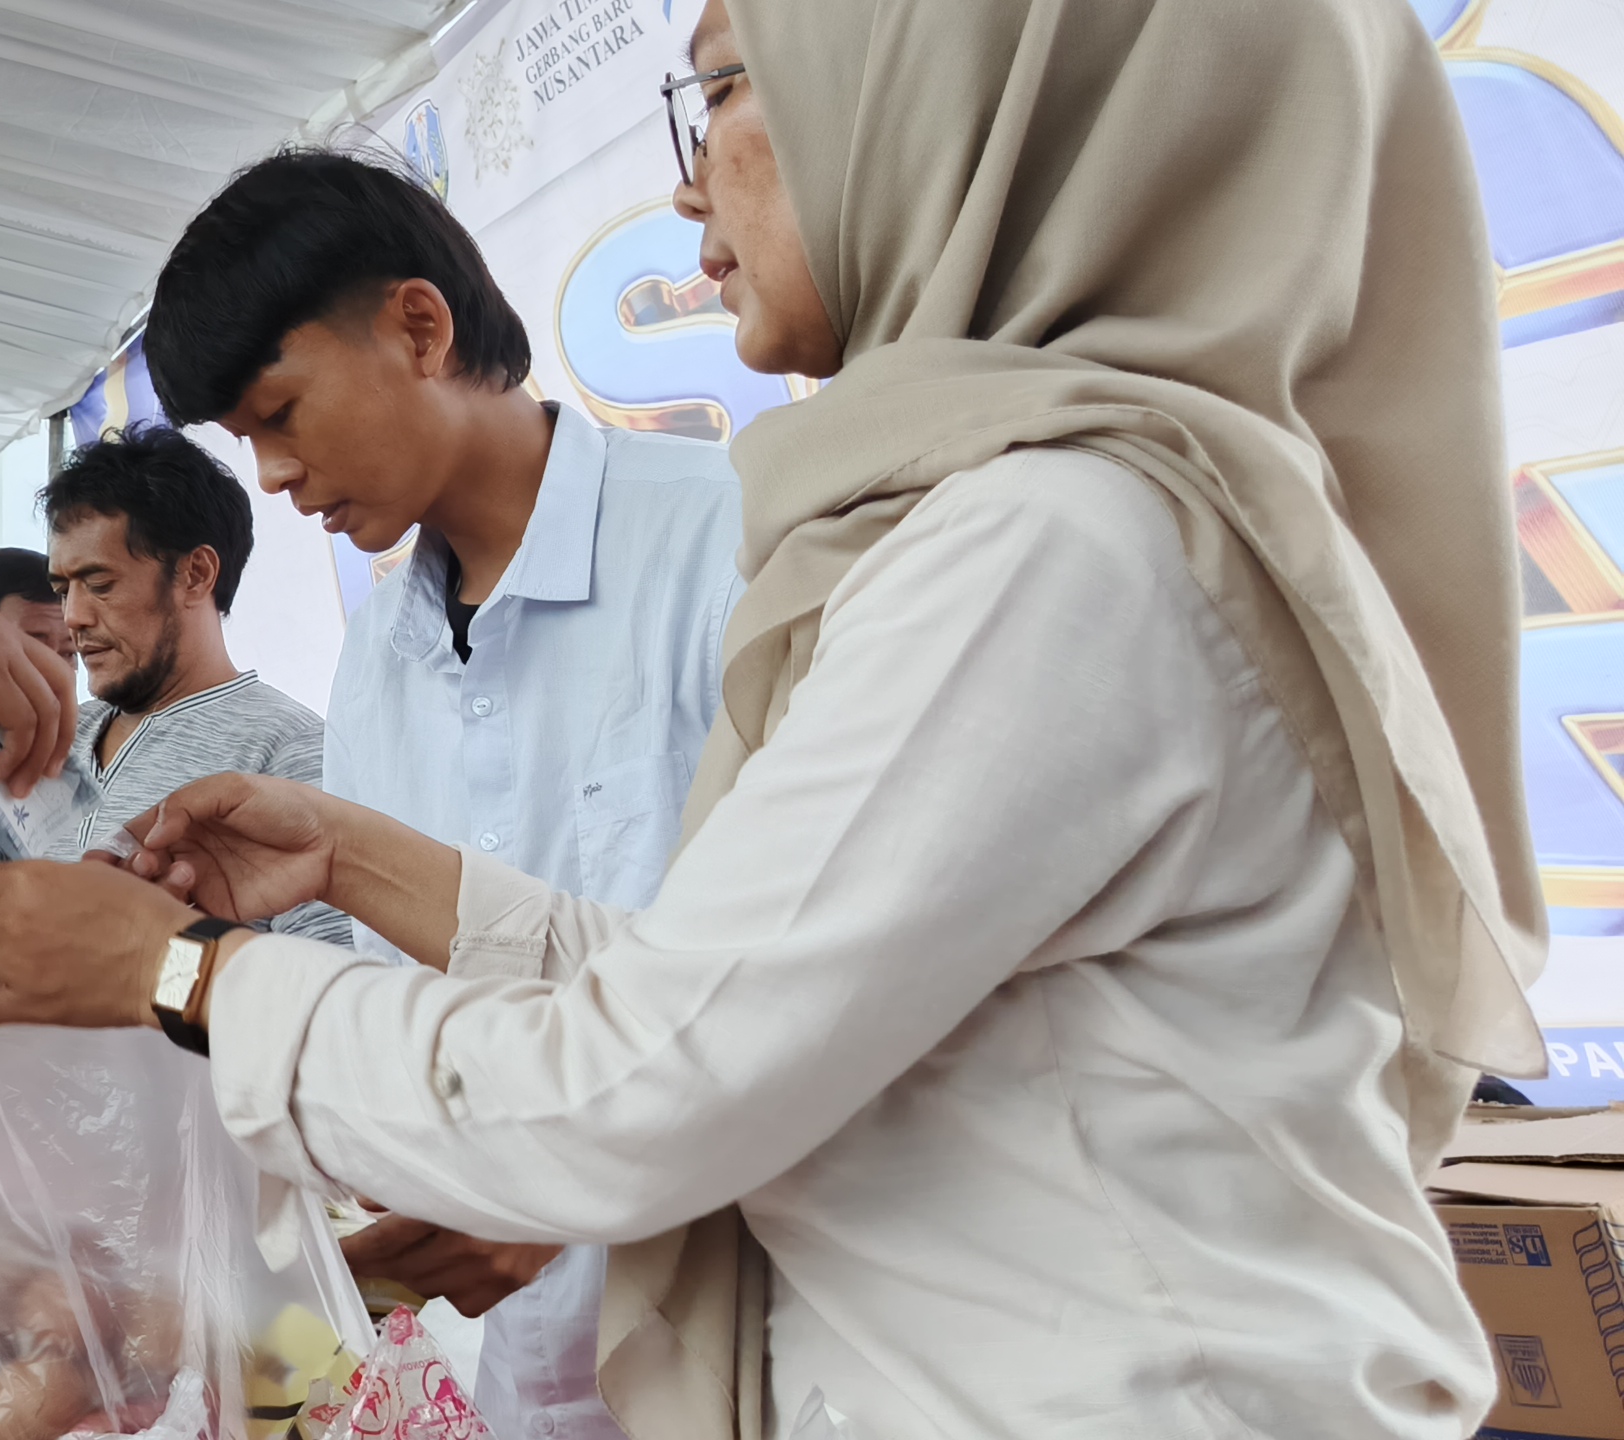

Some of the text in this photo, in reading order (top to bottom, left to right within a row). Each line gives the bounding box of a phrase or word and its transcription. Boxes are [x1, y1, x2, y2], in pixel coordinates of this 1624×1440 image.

[515, 13, 562, 62] JAWA
[525, 22, 590, 84] GERBANG
[533, 16, 644, 112] NUSANTARA
[1546, 1041, 1624, 1079] PA
